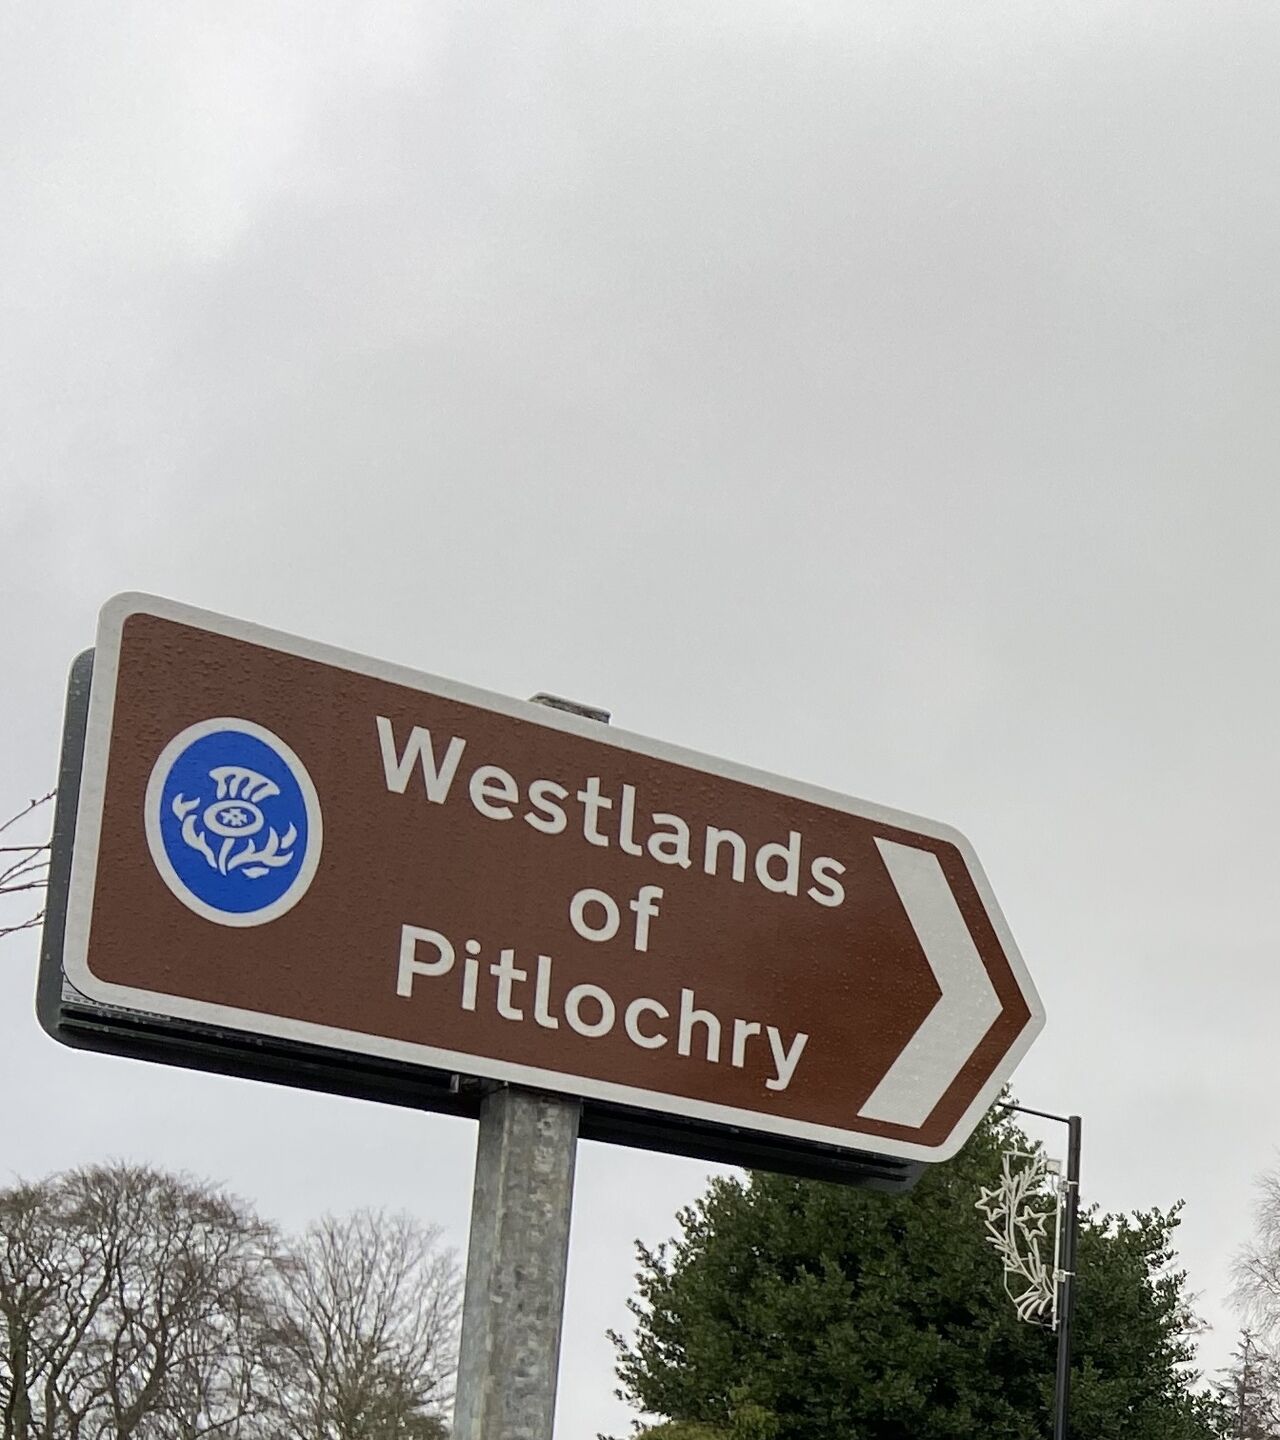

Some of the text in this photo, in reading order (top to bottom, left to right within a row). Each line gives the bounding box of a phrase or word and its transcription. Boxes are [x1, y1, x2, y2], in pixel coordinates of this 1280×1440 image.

[376, 715, 847, 908] Westlands
[569, 885, 664, 952] of
[396, 924, 809, 1091] Pitlochry
